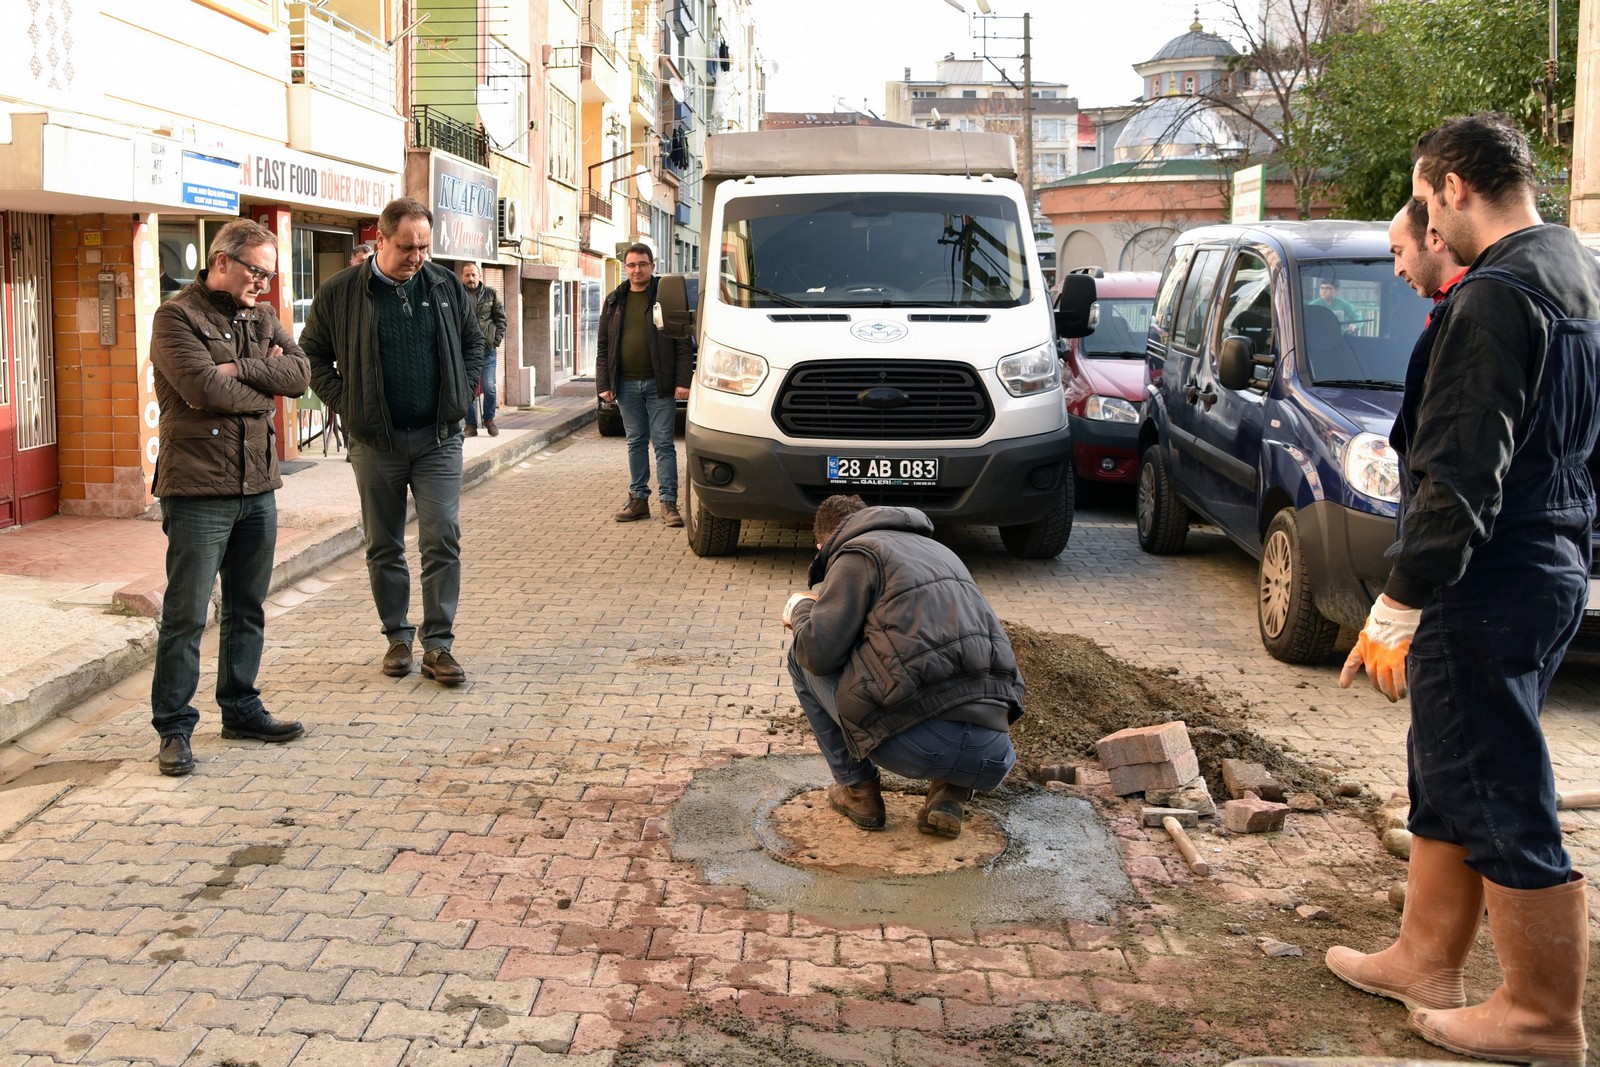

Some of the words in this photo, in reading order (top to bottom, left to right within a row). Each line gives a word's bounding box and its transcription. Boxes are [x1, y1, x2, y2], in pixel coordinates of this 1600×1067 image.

[256, 156, 286, 191] FAST
[290, 163, 317, 197] FOOD
[321, 168, 351, 203] DÖNER
[354, 178, 370, 208] ÇAY
[438, 173, 495, 220] KUAFÖR
[144, 365, 161, 484] FOO
[838, 460, 860, 477] 28
[867, 460, 892, 478] AB
[900, 460, 935, 478] 083
